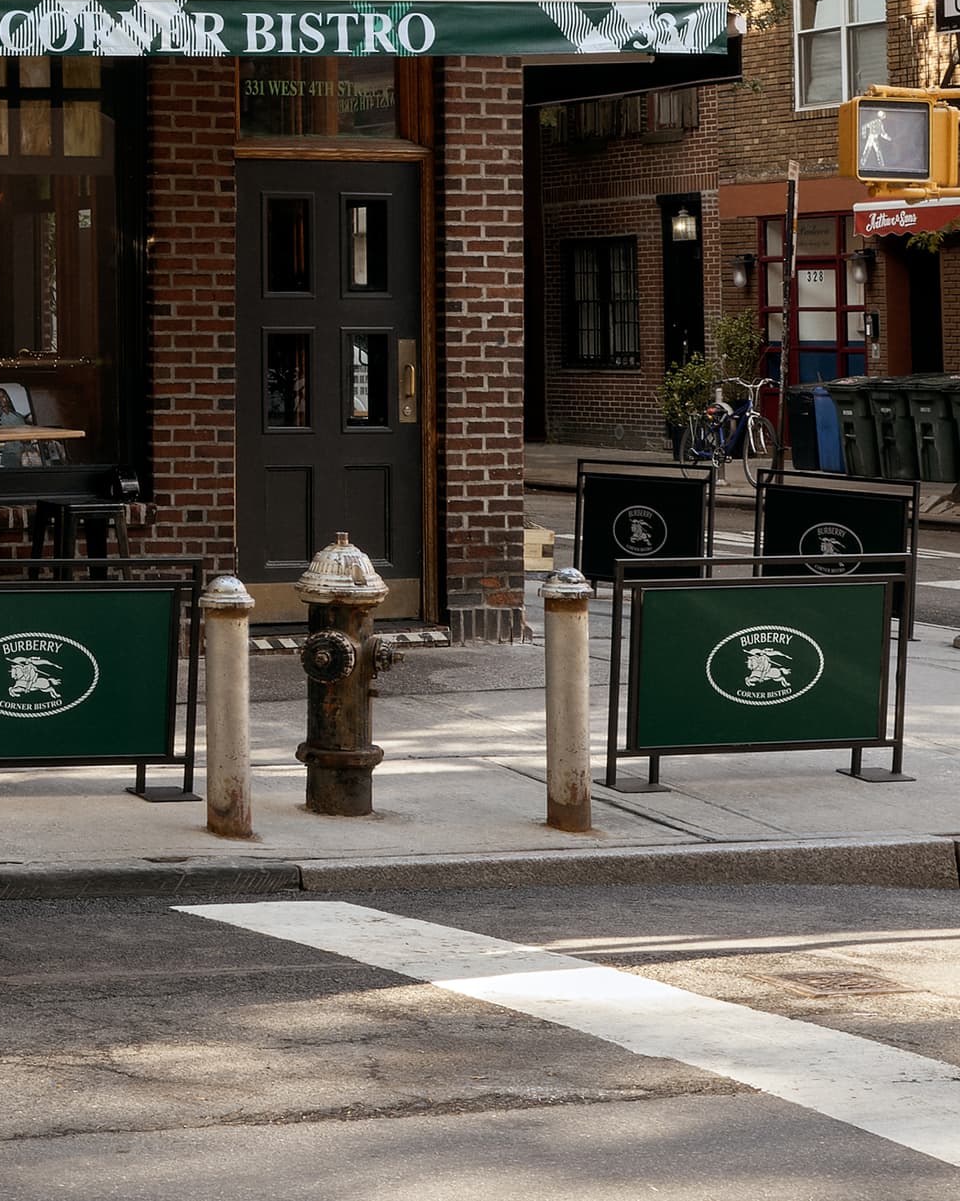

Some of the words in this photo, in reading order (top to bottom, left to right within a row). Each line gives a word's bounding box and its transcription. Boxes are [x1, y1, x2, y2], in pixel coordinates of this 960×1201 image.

[242, 12, 436, 53] BISTRO
[245, 79, 264, 96] 331
[268, 80, 306, 97] WEST
[308, 80, 334, 97] 4TH
[806, 271, 824, 282] 328
[2, 639, 63, 655] BURBERRY
[740, 632, 793, 647] BURBERRY
[737, 689, 766, 699] CORNER
[766, 687, 792, 698] BISTRO
[0, 700, 32, 711] CORNER
[34, 699, 63, 710] BISTRO
